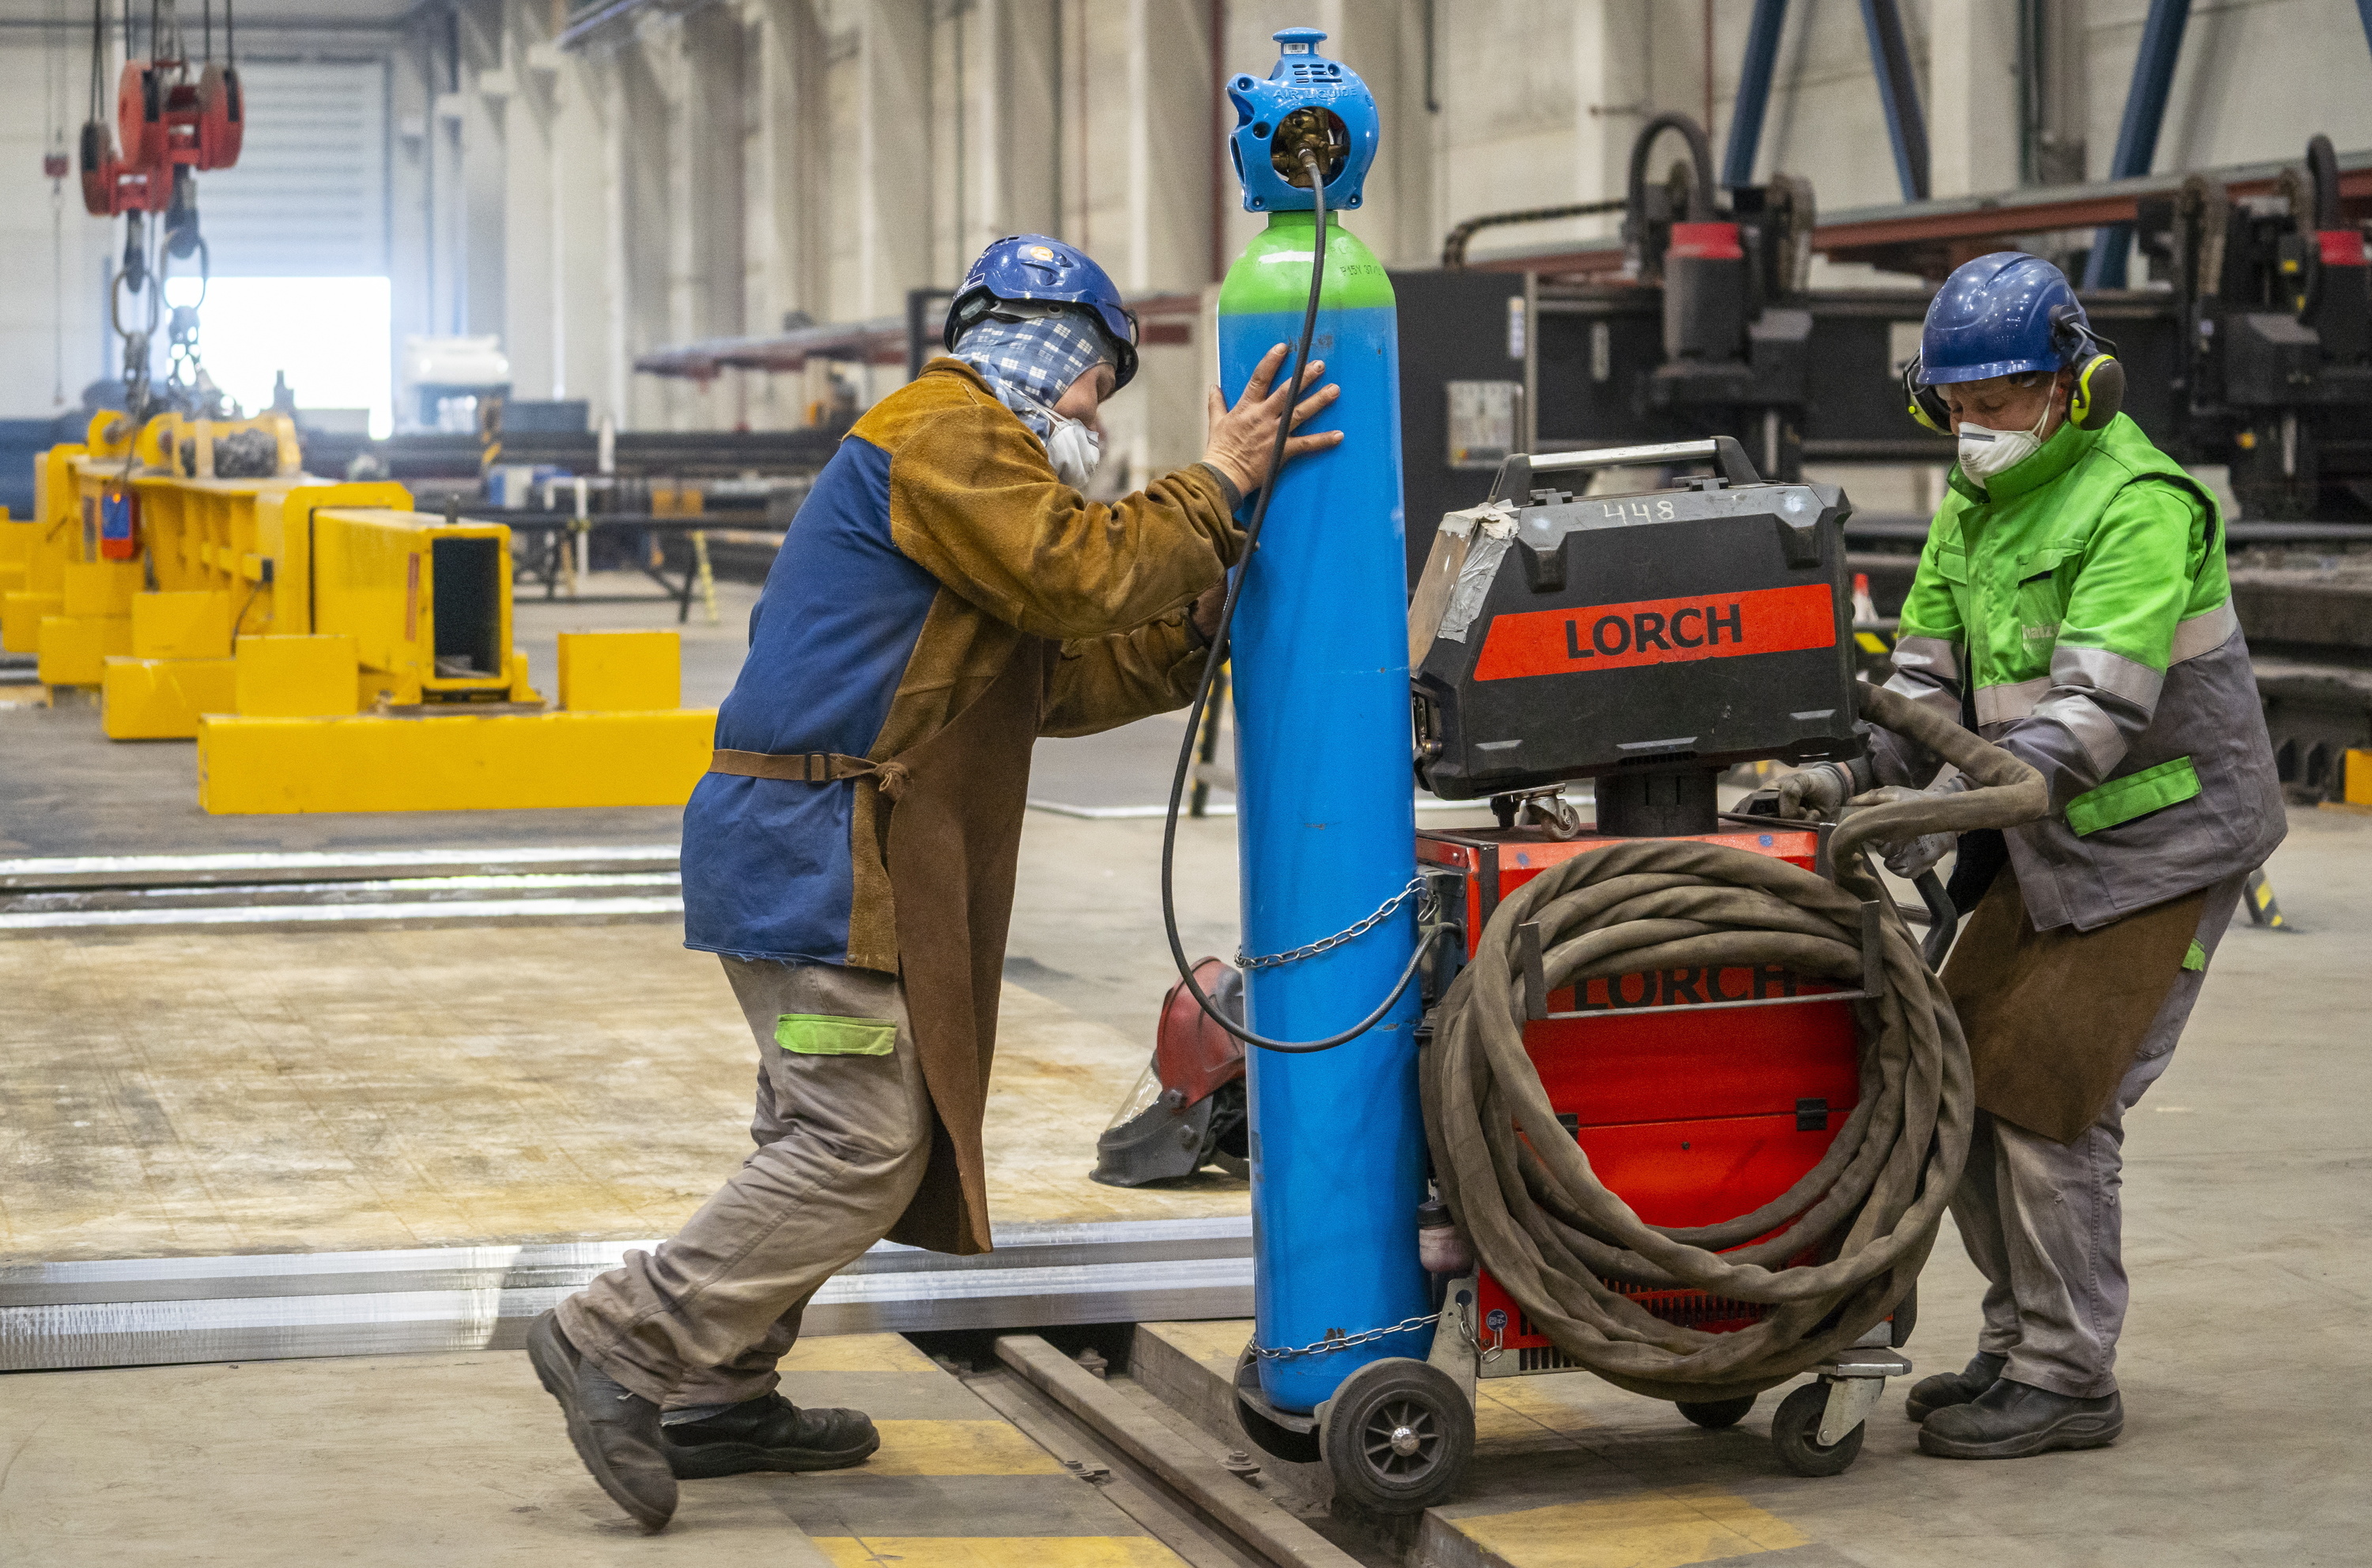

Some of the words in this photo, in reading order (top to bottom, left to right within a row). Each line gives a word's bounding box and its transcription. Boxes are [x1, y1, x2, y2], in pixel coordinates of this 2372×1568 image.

[1273, 89, 1300, 100] AIR
[1305, 87, 1358, 100] LIQUIDE
[1603, 500, 1675, 525] 448
[1566, 603, 1743, 659] LORCH
[1574, 962, 1797, 1011] LORCH
